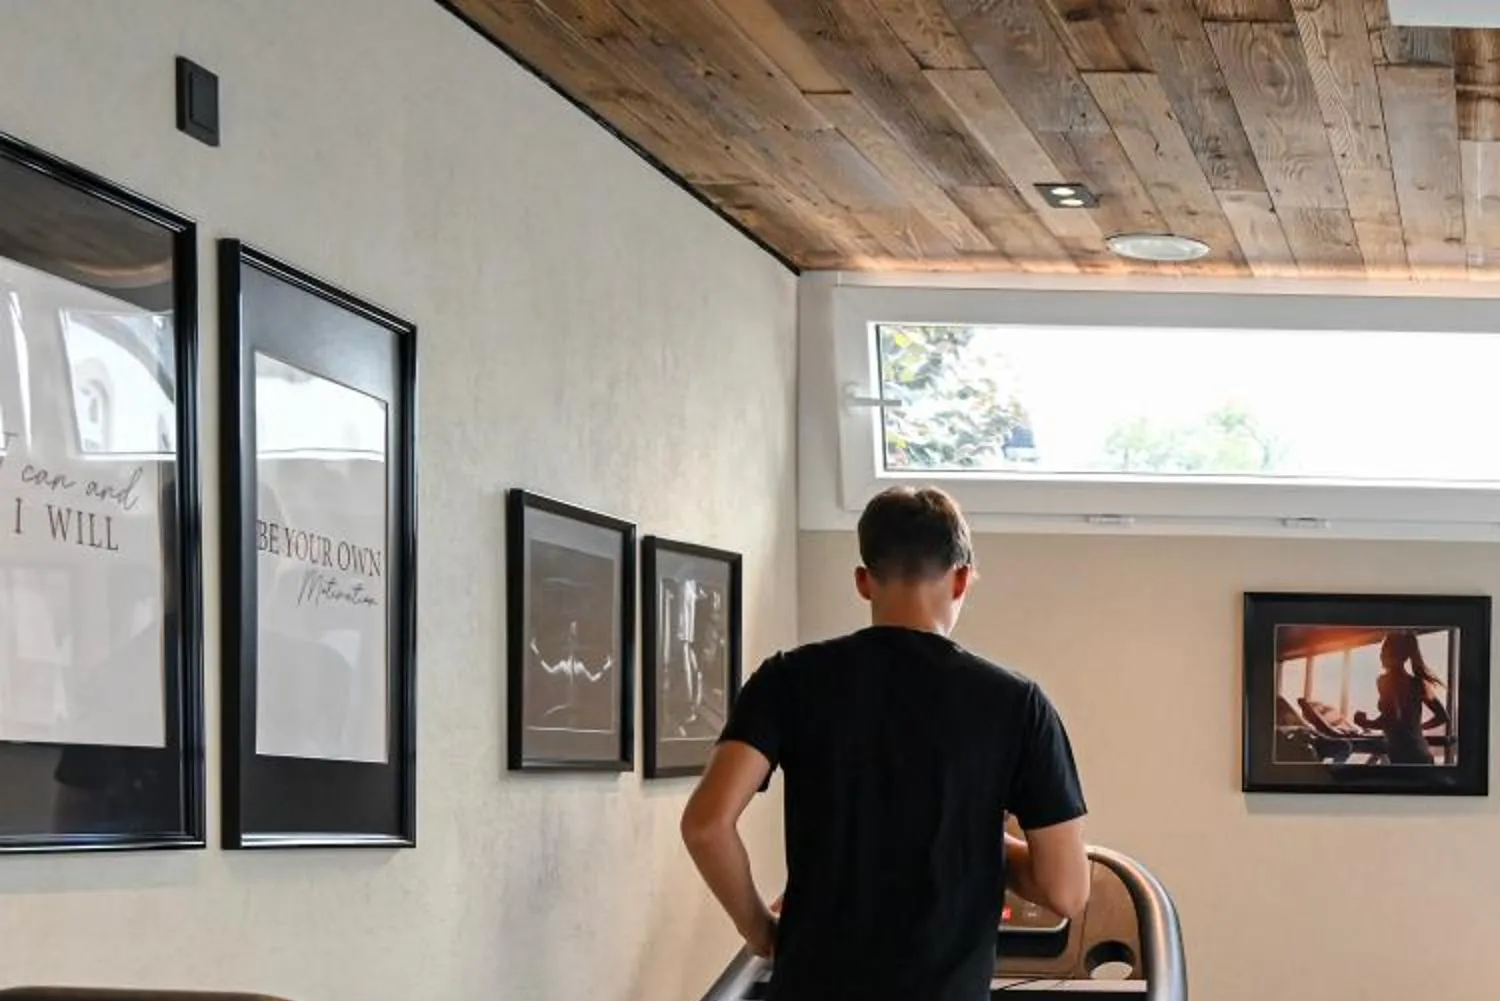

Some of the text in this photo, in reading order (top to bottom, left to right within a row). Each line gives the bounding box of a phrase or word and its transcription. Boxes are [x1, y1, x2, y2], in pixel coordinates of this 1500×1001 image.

[21, 464, 144, 510] can and
[14, 497, 119, 551] I WILL
[256, 519, 381, 577] BE YOUR OWN
